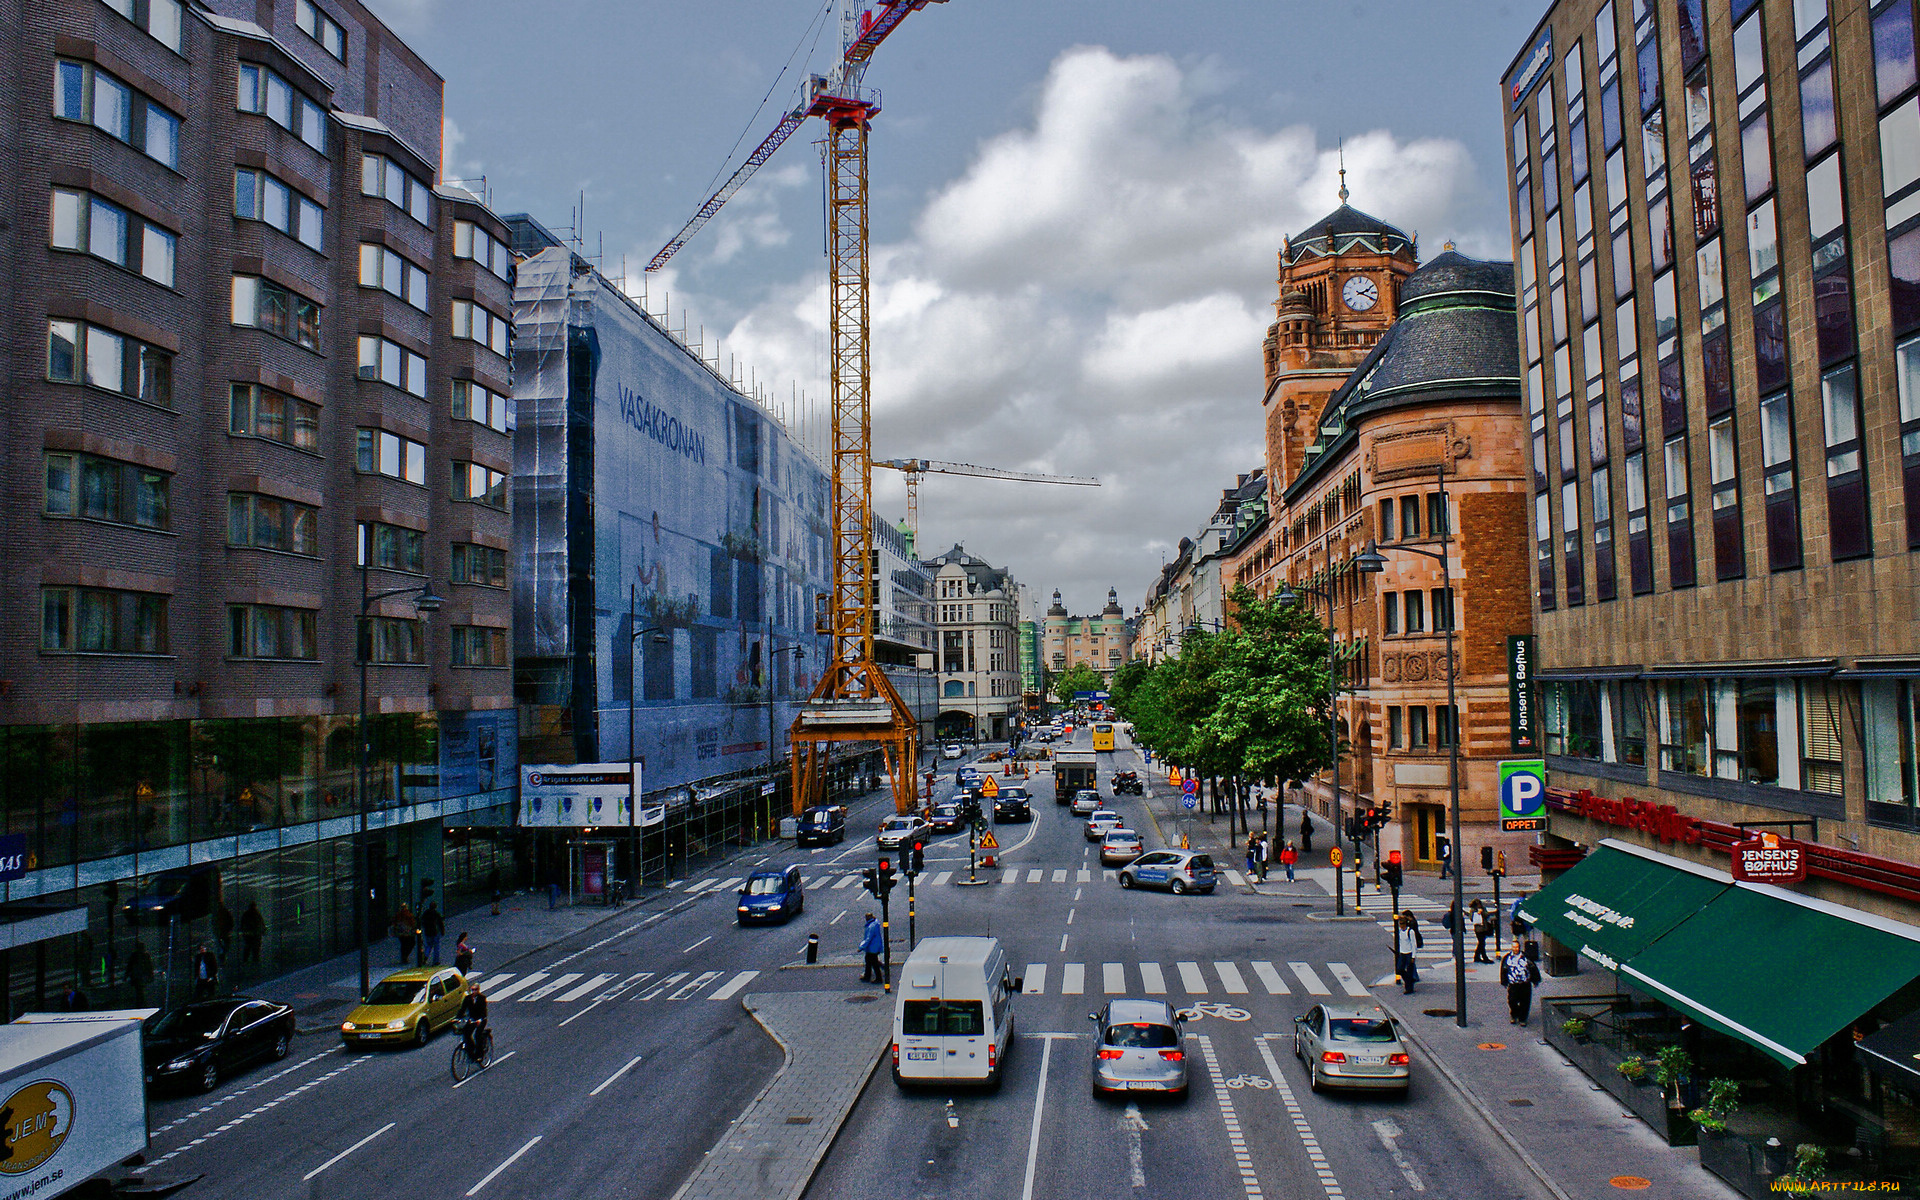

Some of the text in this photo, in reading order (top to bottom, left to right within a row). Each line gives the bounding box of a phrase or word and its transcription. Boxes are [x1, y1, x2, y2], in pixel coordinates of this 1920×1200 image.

[618, 382, 704, 466] VASAKRONAN
[1515, 640, 1527, 680] Bøfhus
[1511, 776, 1540, 811] P
[1332, 852, 1341, 862] 30
[1741, 849, 1800, 861] JENSEN'S
[1744, 860, 1798, 872] BØFHUS
[0, 1148, 49, 1170] TRANSPORT
